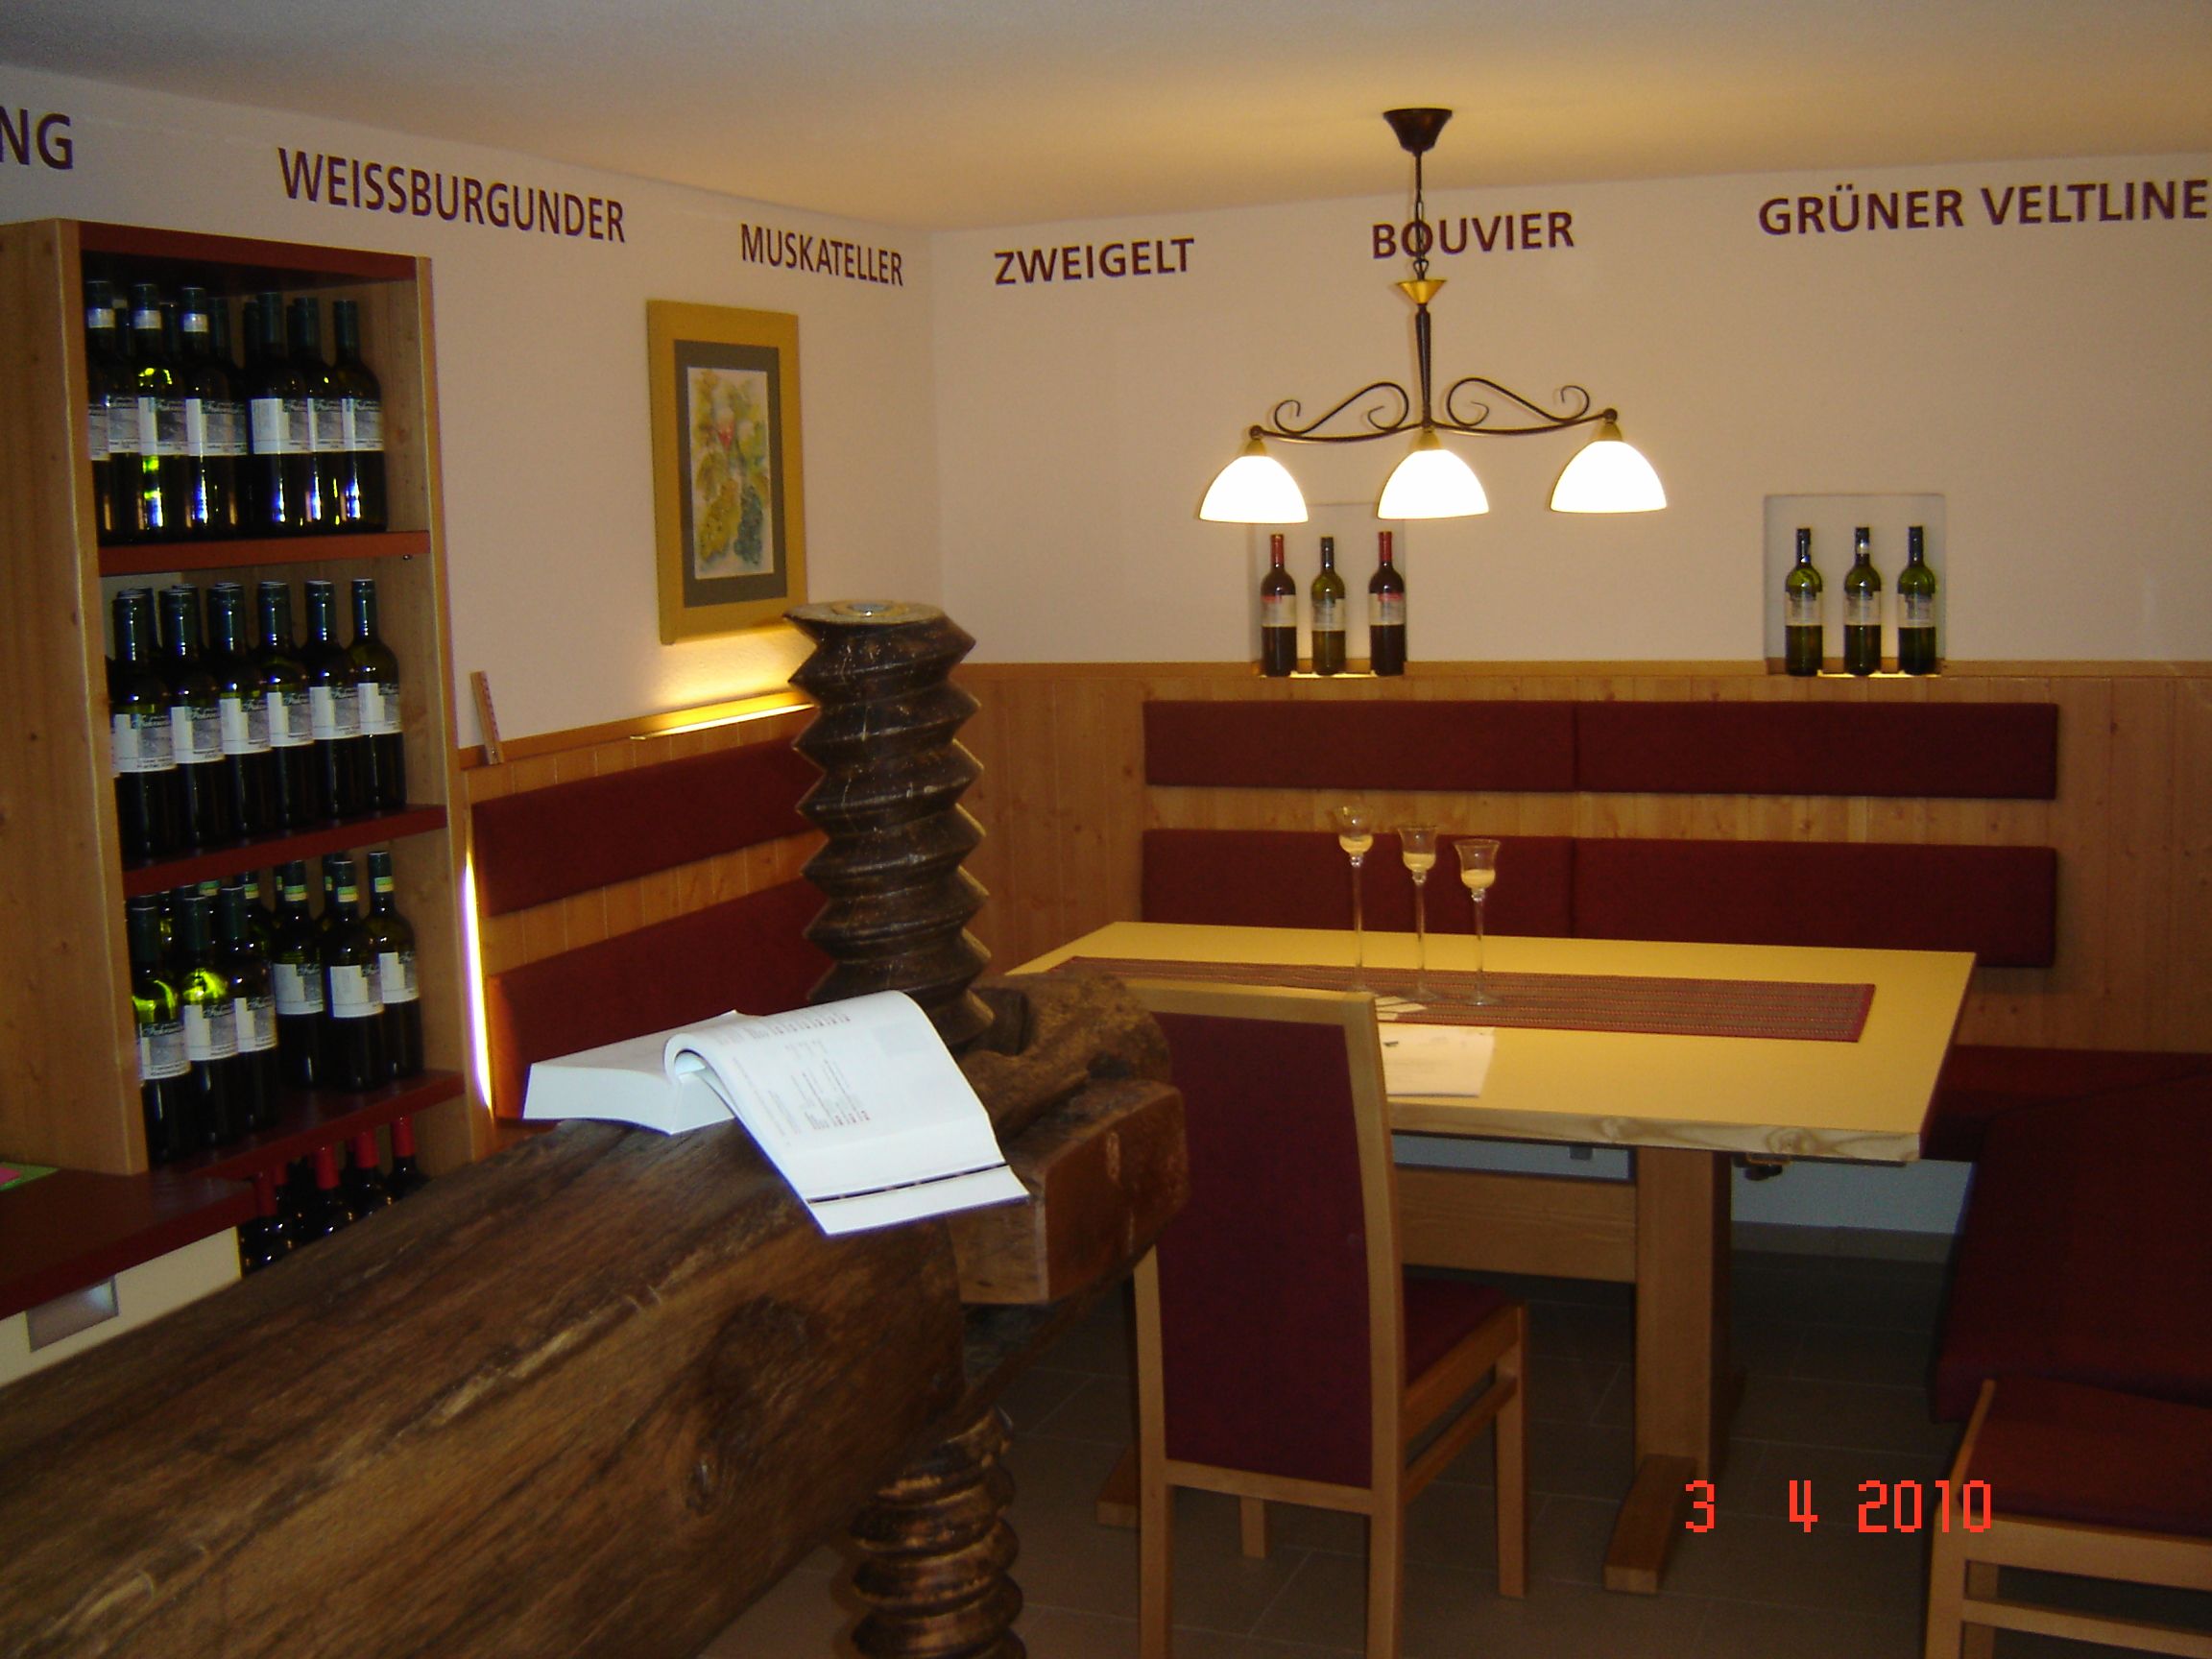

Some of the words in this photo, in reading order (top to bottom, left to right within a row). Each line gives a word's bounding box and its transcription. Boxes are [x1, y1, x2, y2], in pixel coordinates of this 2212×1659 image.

[0, 106, 74, 170] NG
[277, 146, 626, 243] WEISSBURGUNDER
[1759, 183, 1964, 235] GRÜNER
[1981, 179, 2208, 225] VELTLINE
[740, 223, 903, 286] MUSKATELLER
[994, 237, 1194, 286] ZWEIGELT
[1373, 211, 1575, 259] BOUVIER
